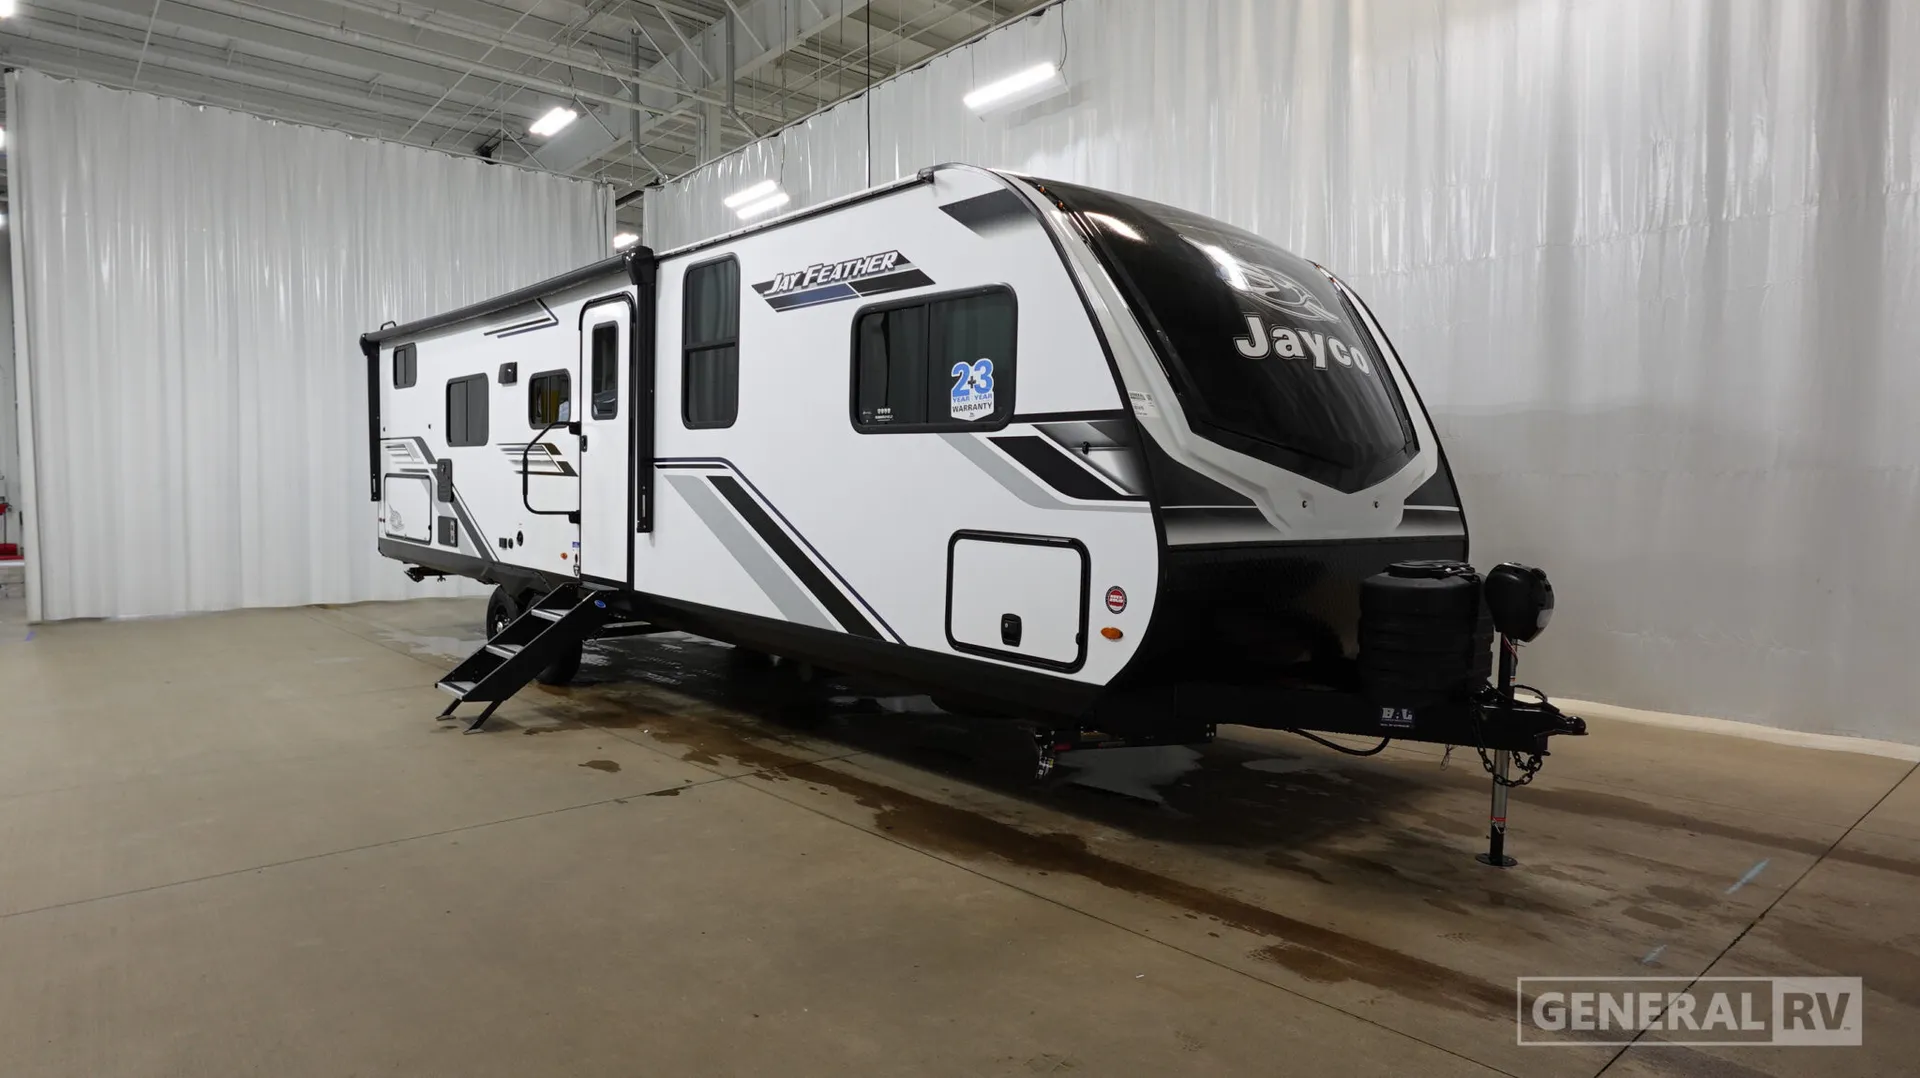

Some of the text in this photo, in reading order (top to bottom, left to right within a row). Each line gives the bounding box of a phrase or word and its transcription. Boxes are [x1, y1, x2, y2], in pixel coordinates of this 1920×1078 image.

[763, 251, 899, 296] JAY FEATHER
[1233, 312, 1370, 375] Jayco
[952, 402, 993, 413] WARRANTY
[974, 393, 993, 401] YEAR
